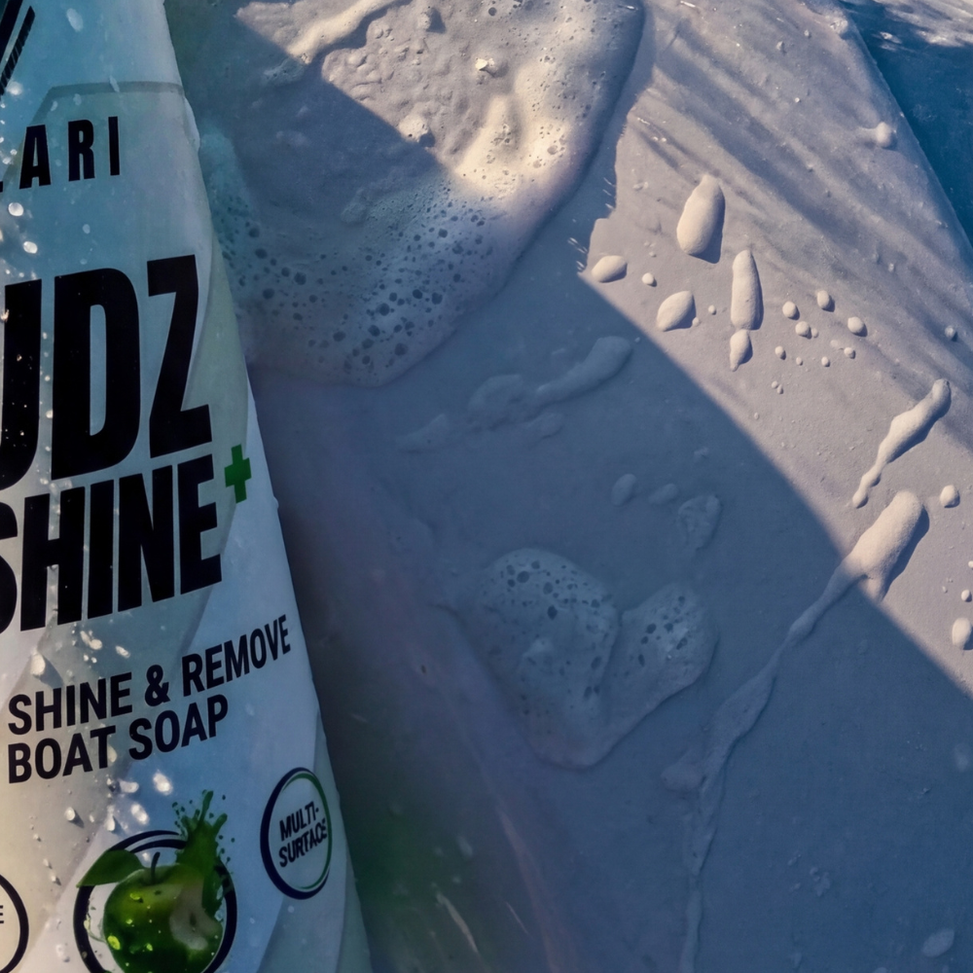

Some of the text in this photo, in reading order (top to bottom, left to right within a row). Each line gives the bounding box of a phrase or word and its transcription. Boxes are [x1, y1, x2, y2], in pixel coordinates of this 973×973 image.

[8, 672, 133, 735] SHINE
[144, 664, 171, 707] &
[181, 614, 291, 697] REMOVE
[8, 693, 229, 784] BOAT SOAP
[279, 801, 320, 842] MULTI-
